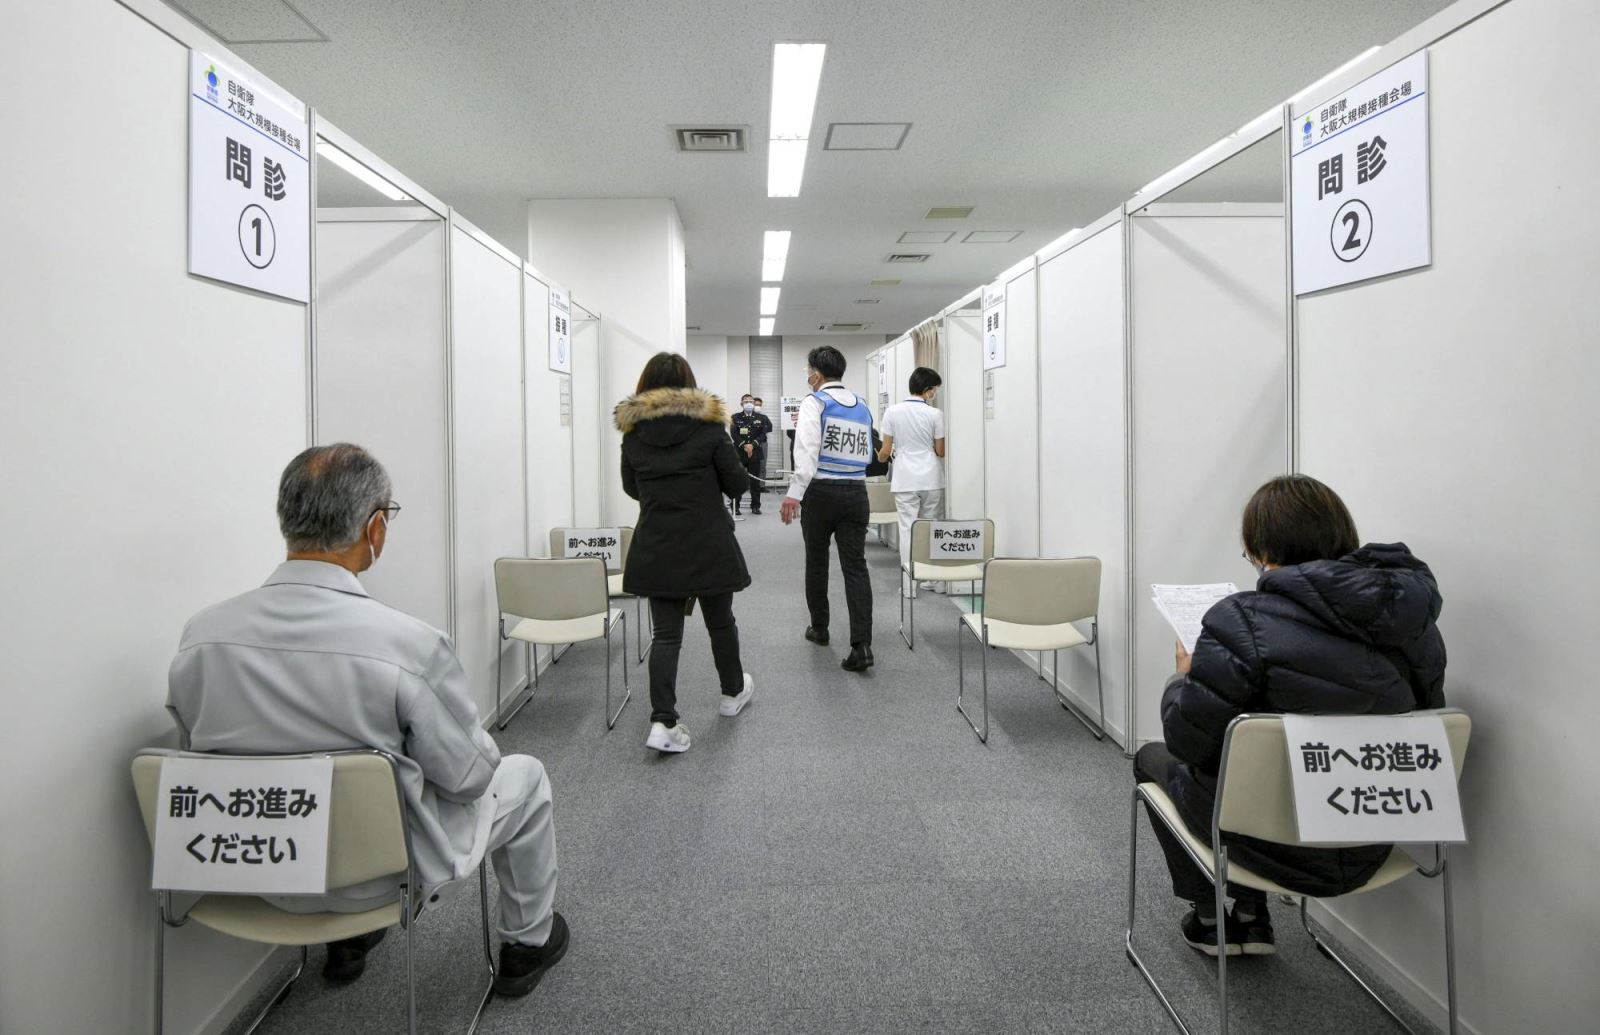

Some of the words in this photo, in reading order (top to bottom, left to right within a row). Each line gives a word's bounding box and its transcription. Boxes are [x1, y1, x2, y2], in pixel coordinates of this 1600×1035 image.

[228, 80, 254, 106] 自衛隊
[228, 98, 301, 152] 大阪大規模接種会場
[1320, 81, 1412, 138] 大阪大規模接種会場
[1320, 98, 1347, 123] 自衛隊
[226, 136, 286, 201] 問診
[1318, 135, 1388, 201] 問診
[823, 424, 869, 456] 案内係
[567, 537, 617, 548] 前へお進み
[934, 529, 981, 539] 前へお進み
[940, 542, 975, 552] ください
[1300, 742, 1442, 773] 前へお進み
[169, 785, 318, 819] 前へお進み
[1326, 785, 1433, 816] ください
[186, 832, 297, 865] ください
